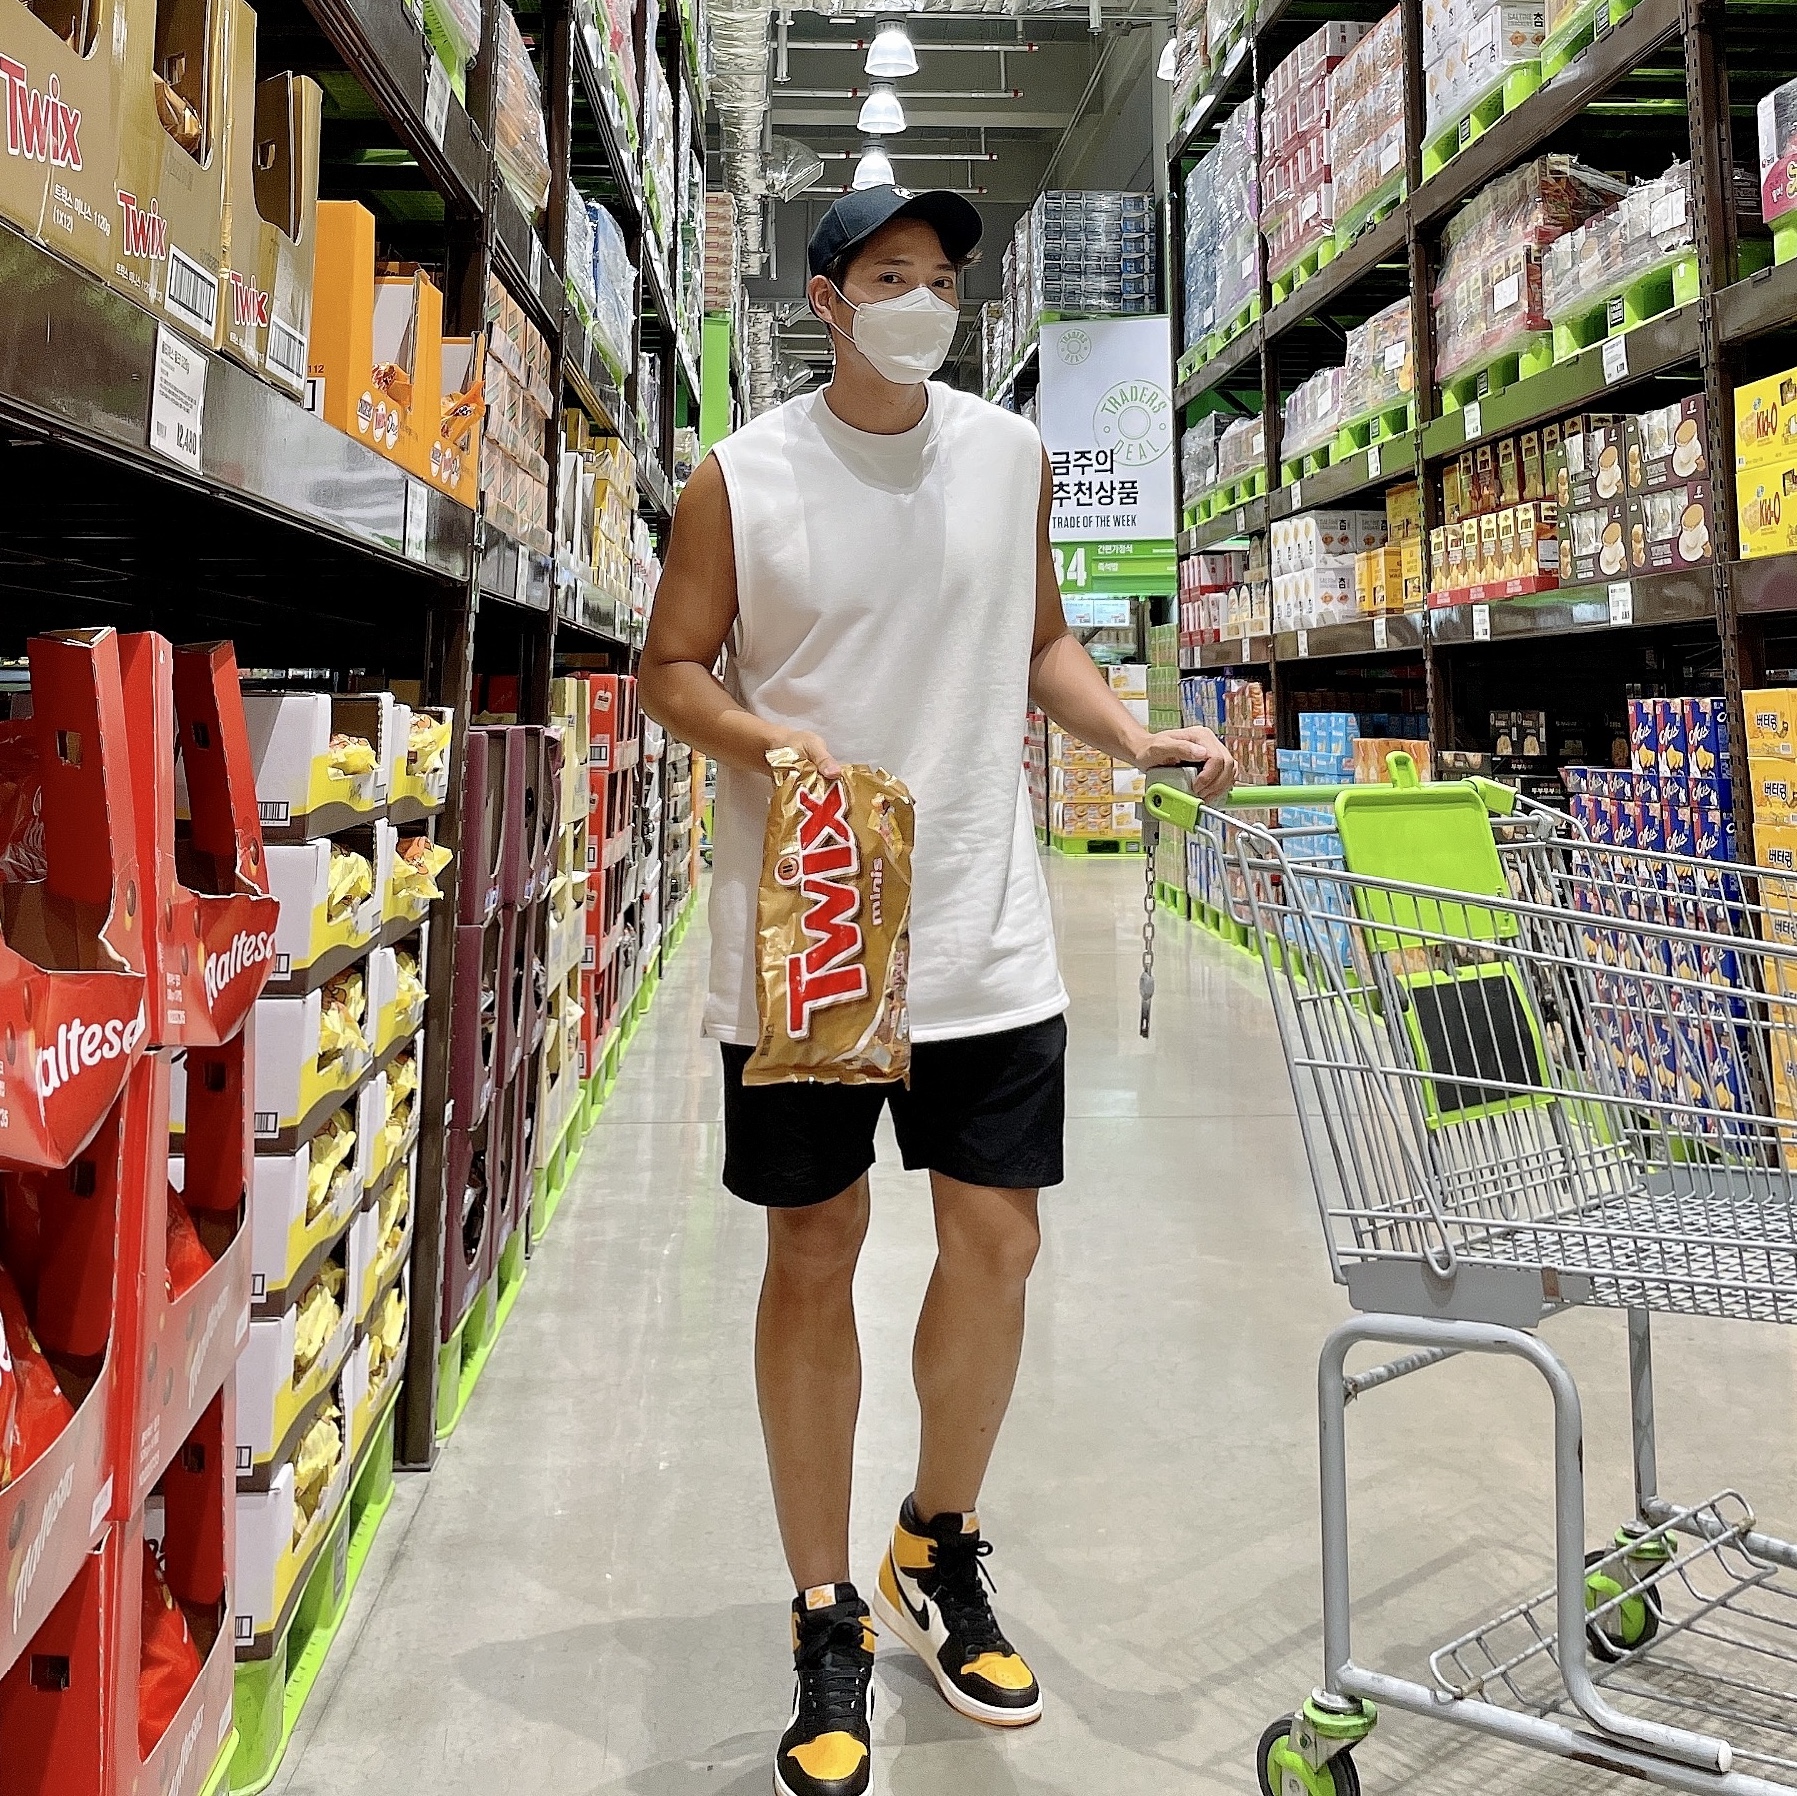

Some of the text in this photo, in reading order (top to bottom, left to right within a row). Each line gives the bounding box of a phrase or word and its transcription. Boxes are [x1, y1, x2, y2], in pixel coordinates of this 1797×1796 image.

[0, 53, 82, 171] Twix
[94, 211, 111, 237] 1120g
[117, 189, 167, 260] Twix
[230, 270, 268, 327] Twix
[1100, 385, 1167, 415] TRADERS
[1050, 448, 1114, 476] 금주의
[1113, 439, 1160, 461] DEAL
[1052, 480, 1139, 507] 추천상품
[1052, 514, 1137, 529] TRADE OF THE WEEK
[1756, 714, 1777, 731] 버터링
[1764, 782, 1788, 801] 버터링
[1768, 848, 1793, 870] 버터링
[870, 858, 884, 926] minis
